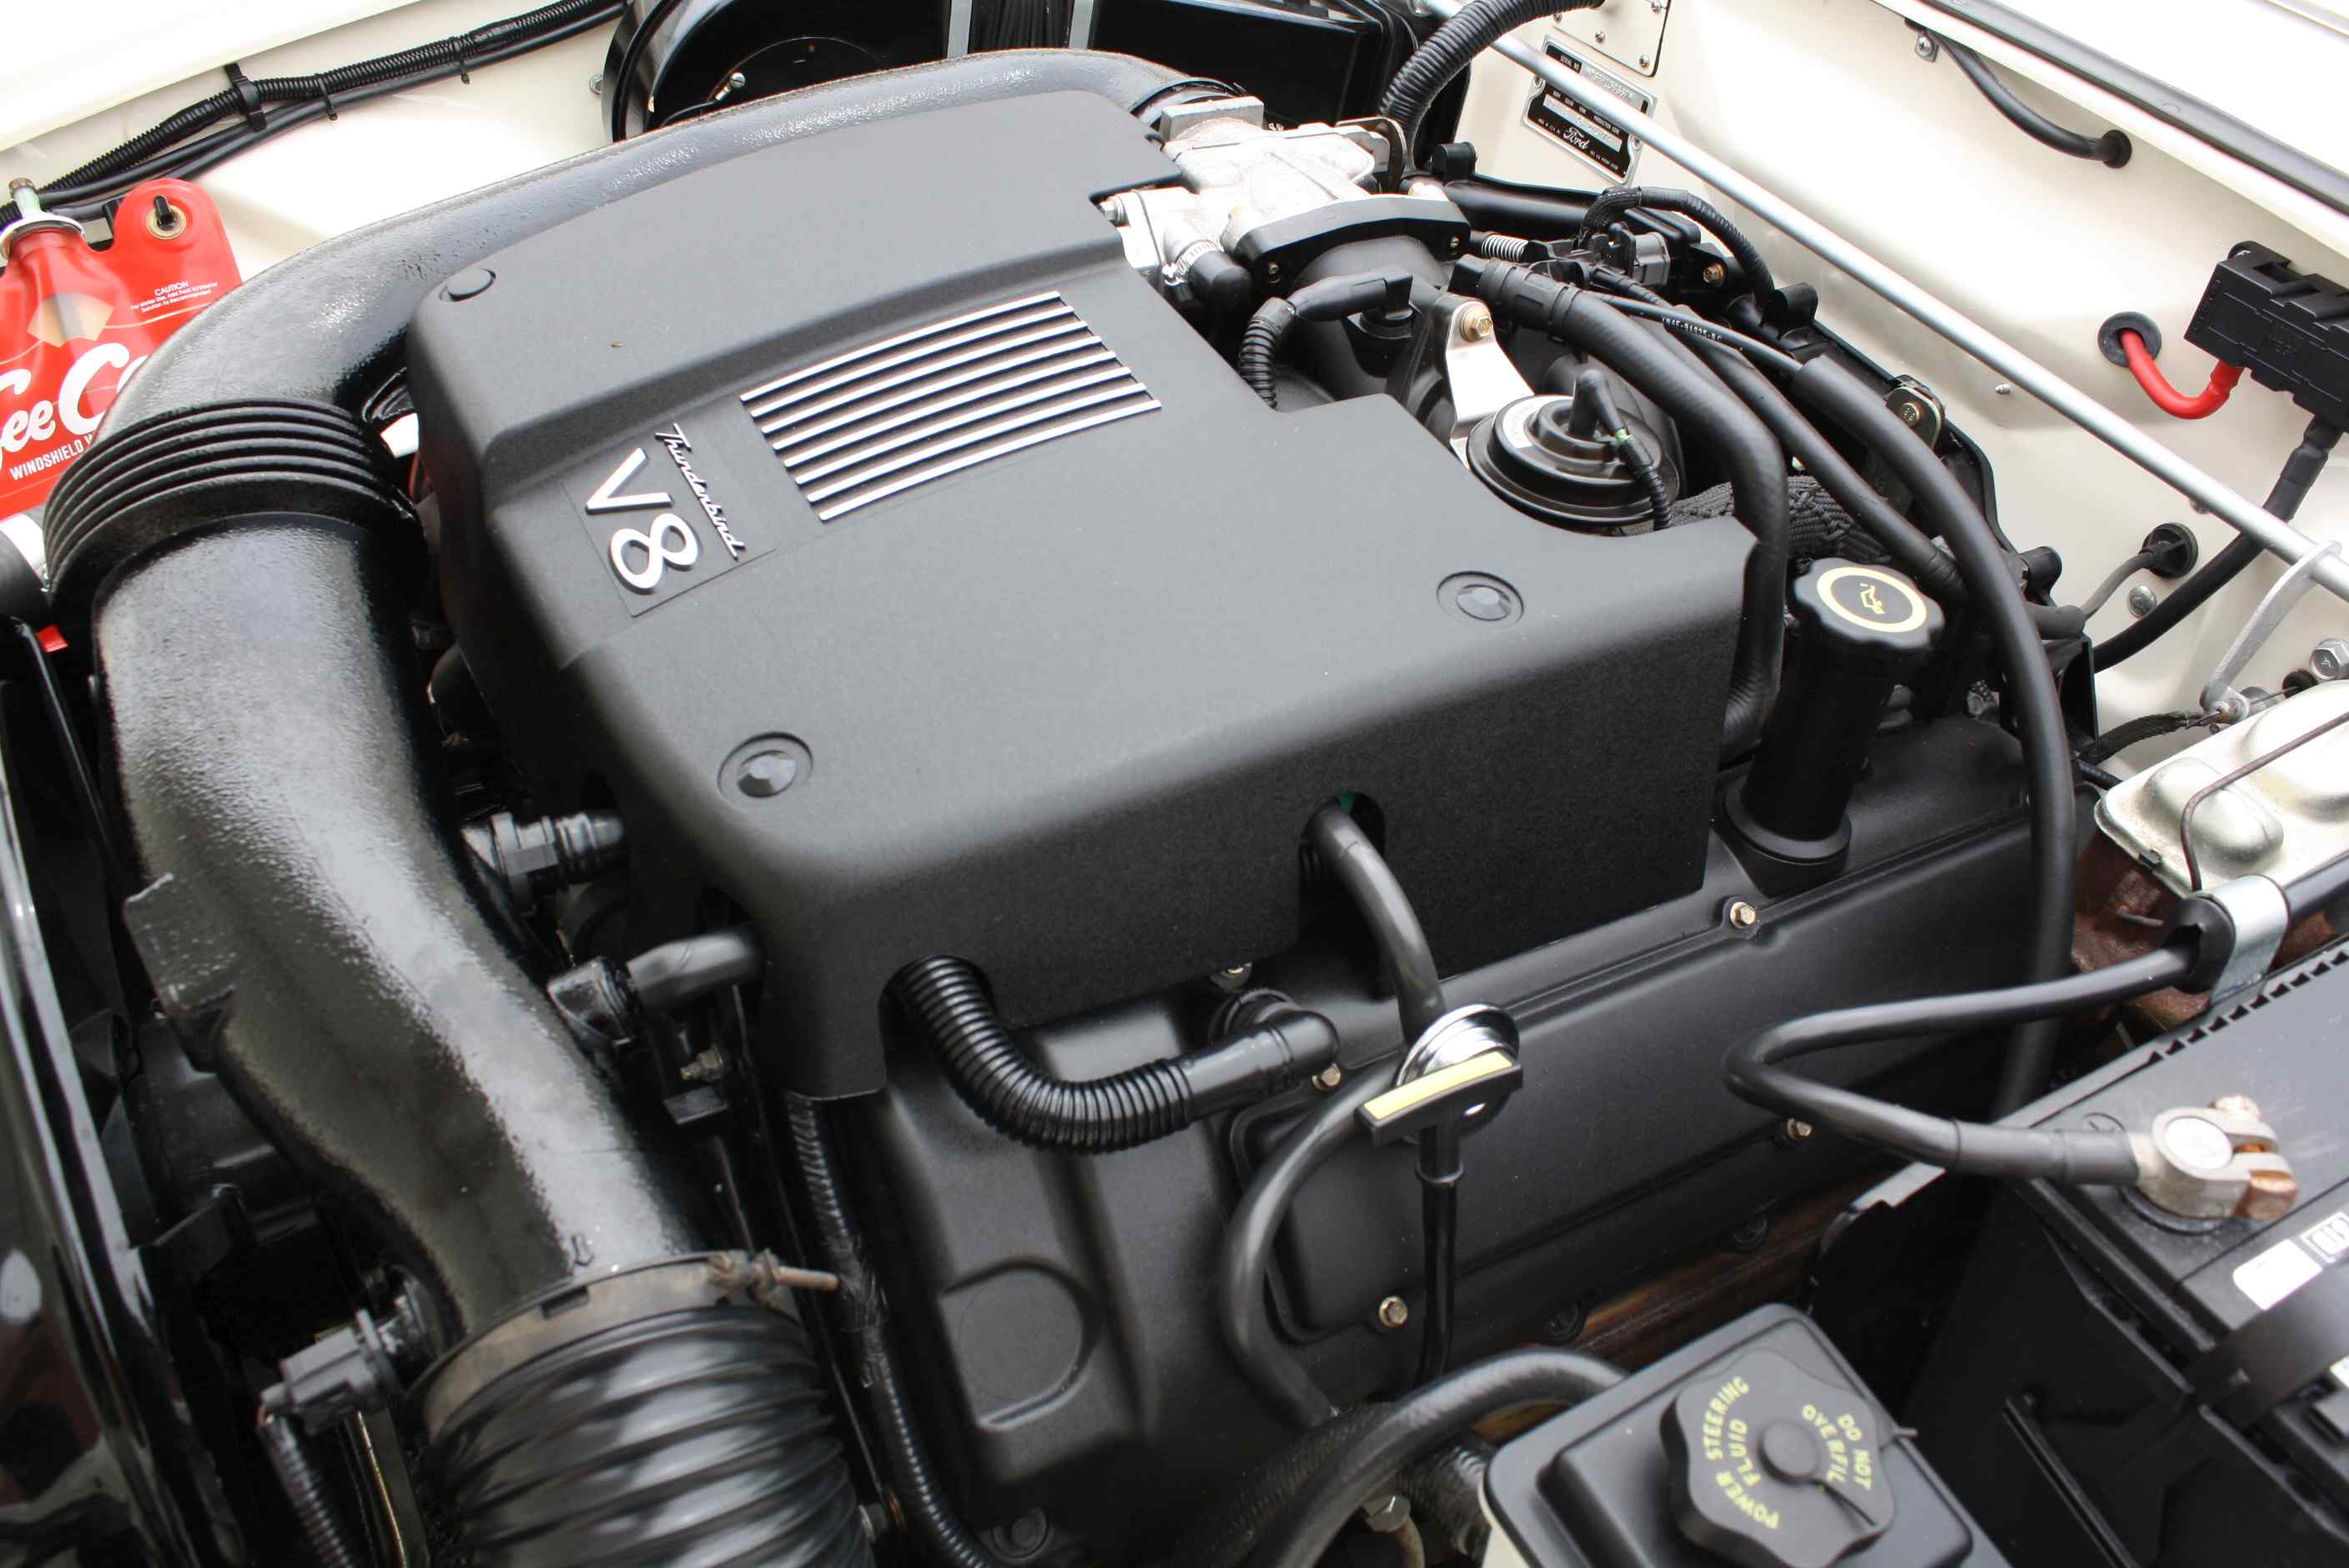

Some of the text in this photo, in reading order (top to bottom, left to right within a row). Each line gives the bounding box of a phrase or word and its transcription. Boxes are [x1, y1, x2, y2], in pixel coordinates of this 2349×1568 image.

[1562, 127, 1590, 149] Ford
[153, 280, 189, 296] CAUTION
[9, 439, 84, 480] WINDSHIELD
[654, 422, 746, 560] Thunderbird
[586, 447, 701, 593] V8
[1703, 1376, 1780, 1530] POWER STEERING
[1728, 1419, 1762, 1487] FLUID
[1837, 1413, 1873, 1491] DO NOT
